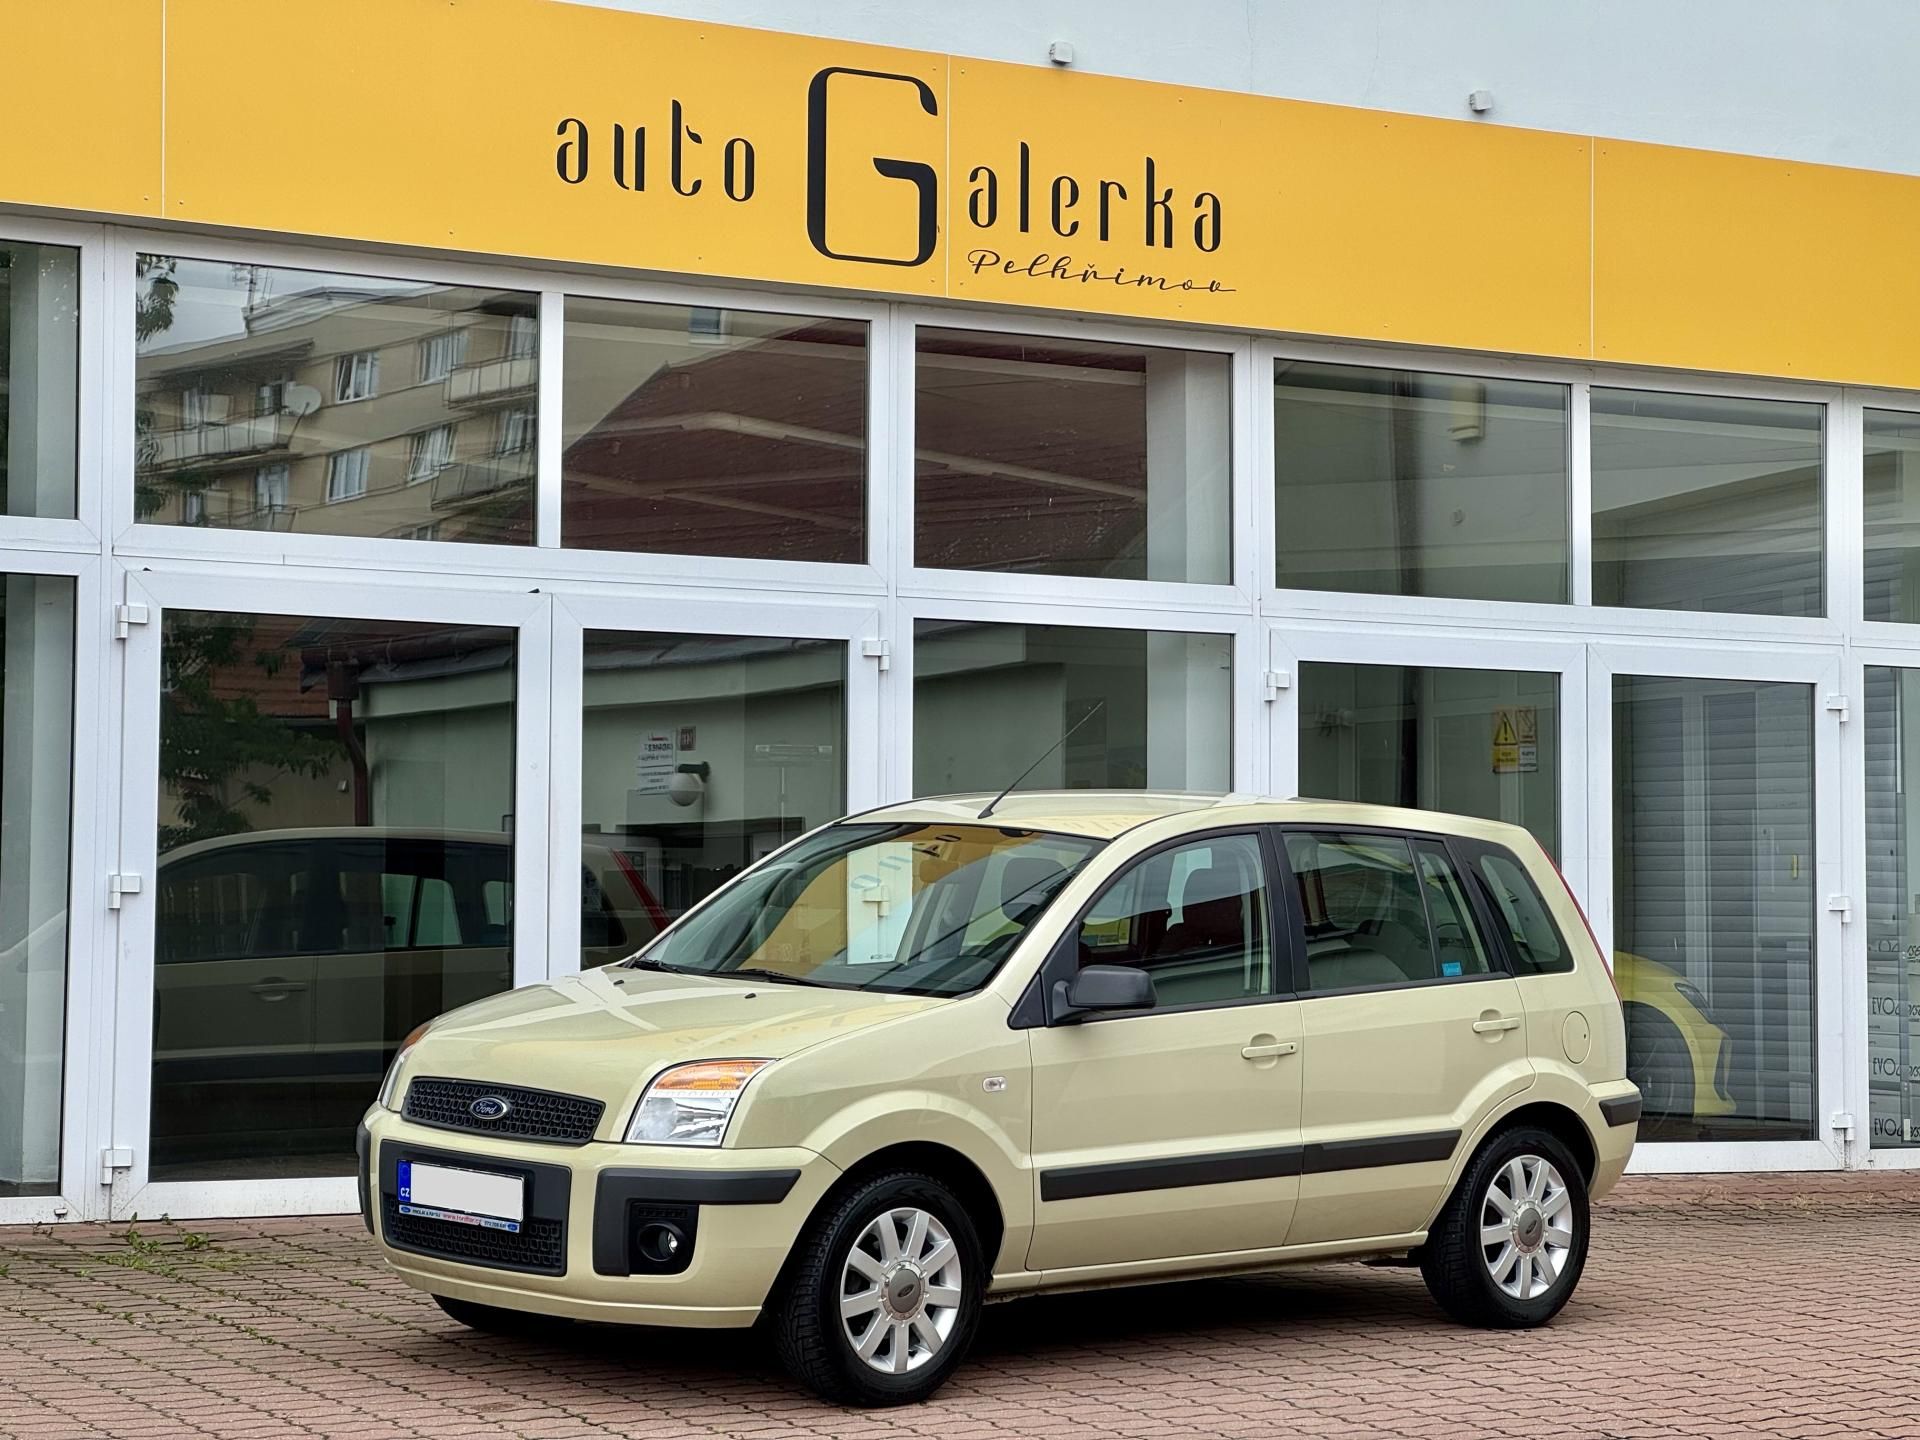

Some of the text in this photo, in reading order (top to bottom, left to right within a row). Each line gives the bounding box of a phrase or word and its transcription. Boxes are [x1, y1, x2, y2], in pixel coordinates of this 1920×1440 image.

[556, 99, 755, 202] auto
[967, 249, 1237, 293] Pelhřimov
[475, 1100, 498, 1115] Ford
[400, 1187, 410, 1198] CZ
